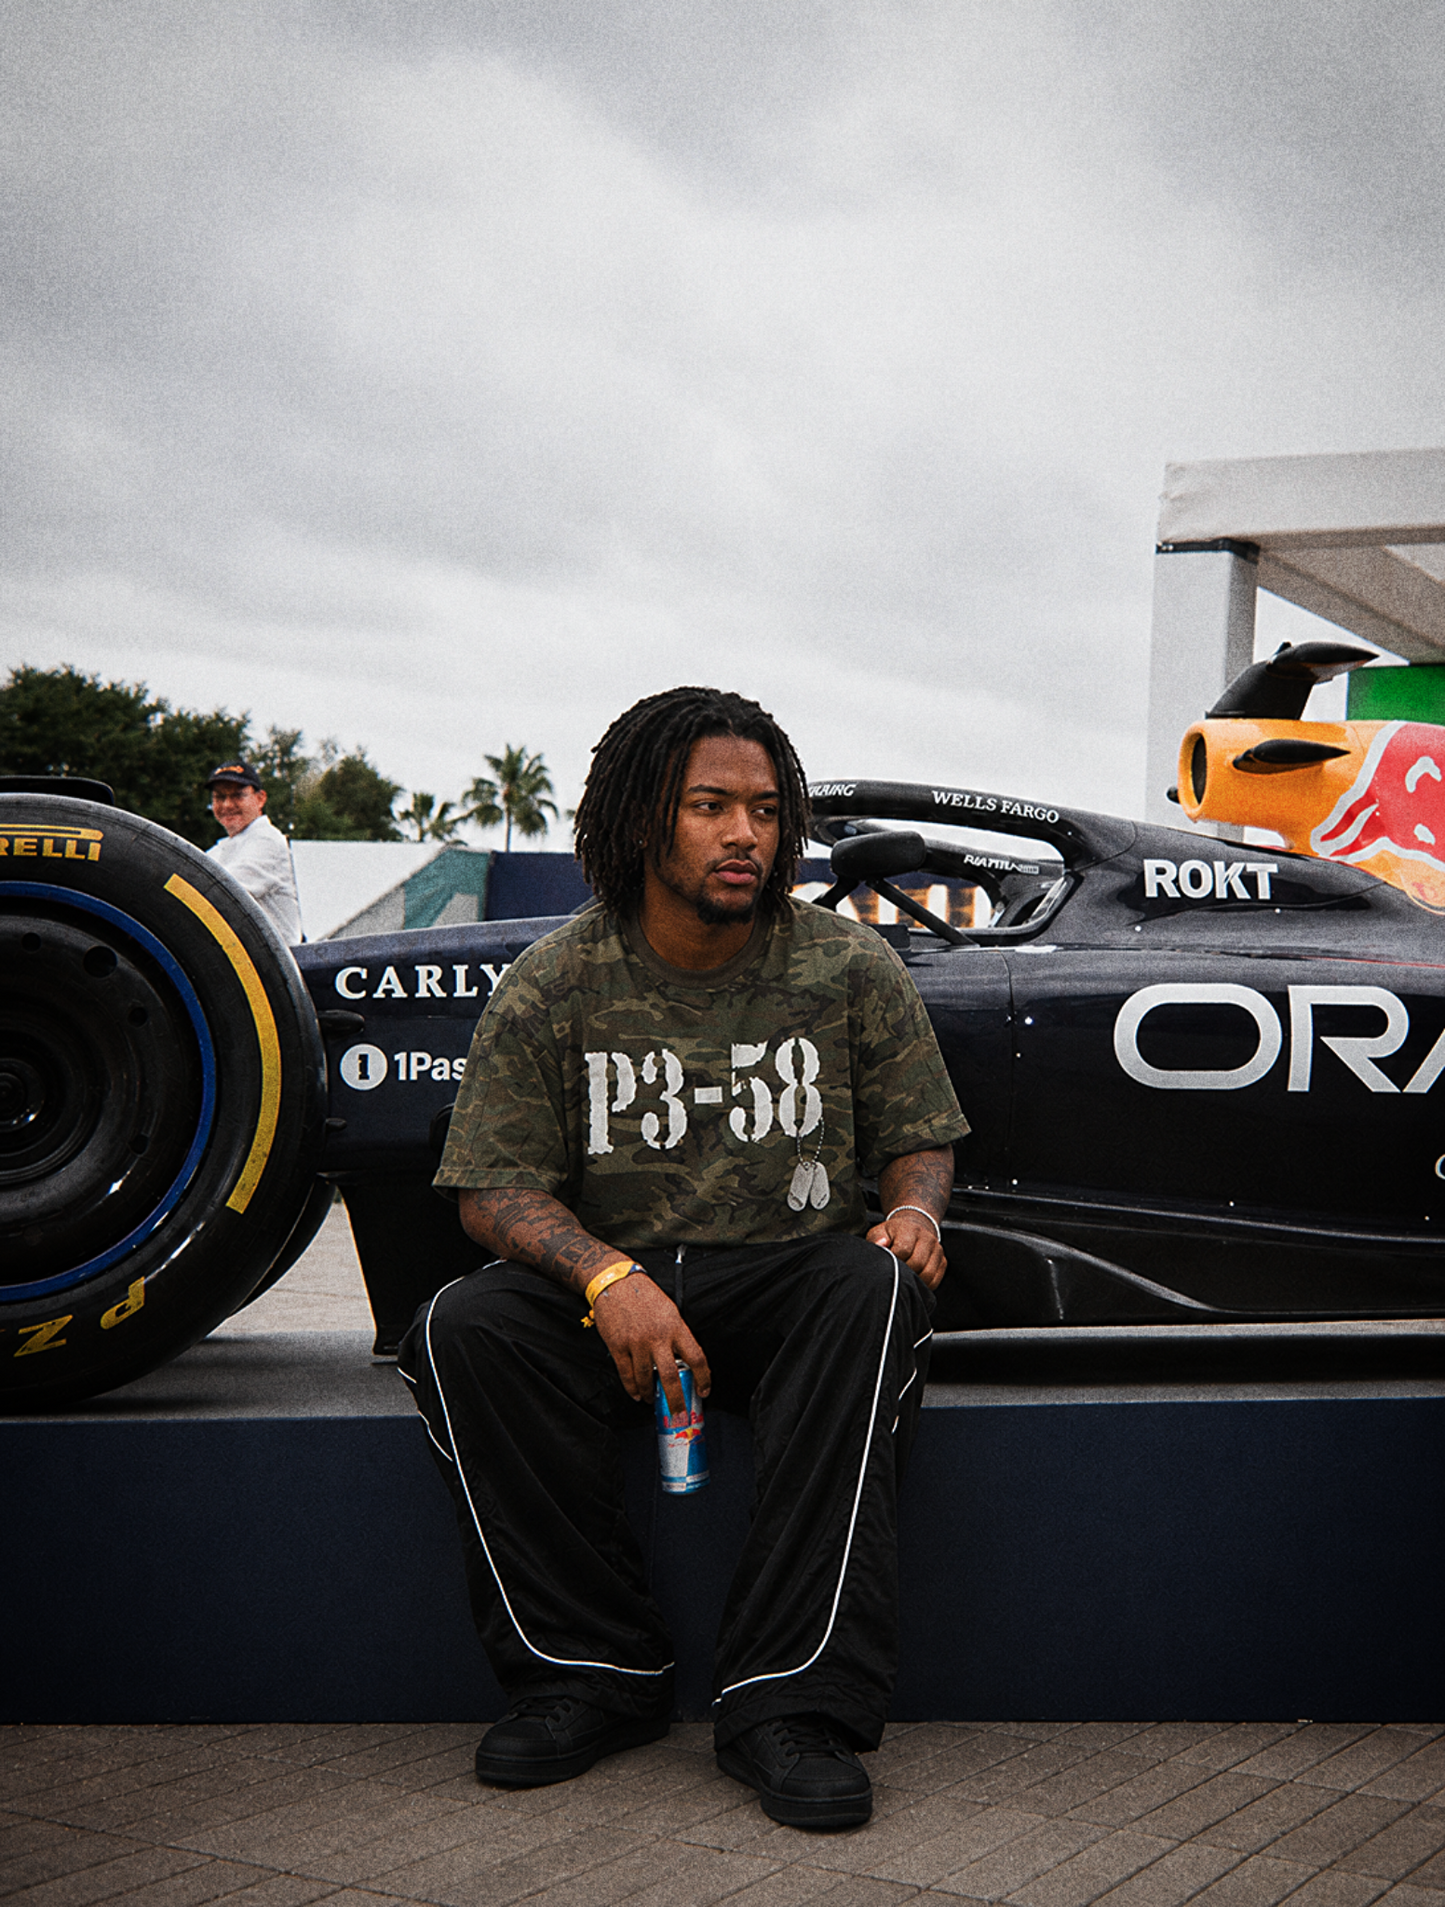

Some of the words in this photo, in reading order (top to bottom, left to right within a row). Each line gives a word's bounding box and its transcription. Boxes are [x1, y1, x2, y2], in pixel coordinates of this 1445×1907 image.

[931, 790, 998, 812] WELLS
[1000, 800, 1060, 824] FARGO
[1143, 859, 1279, 899] ROKT
[584, 1037, 824, 1155] P3-58
